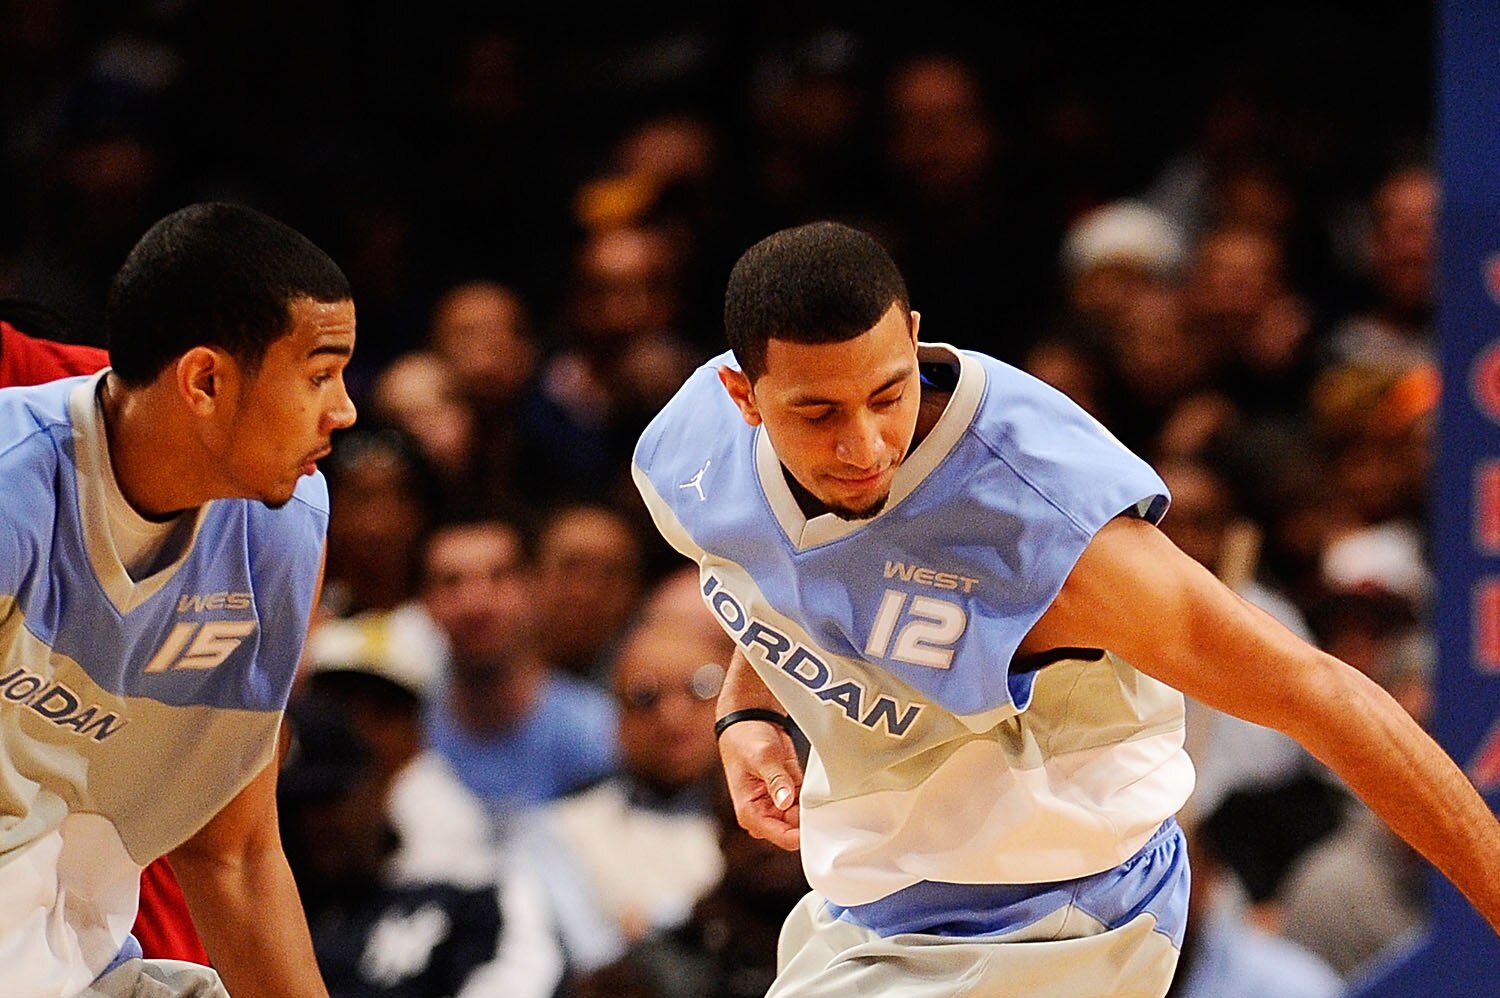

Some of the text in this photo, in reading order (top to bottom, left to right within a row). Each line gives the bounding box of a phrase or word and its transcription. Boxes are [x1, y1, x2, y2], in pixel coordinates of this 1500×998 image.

[176, 591, 252, 613] WES
[883, 560, 979, 593] WEST
[143, 620, 258, 673] 15
[864, 588, 968, 670] 12
[0, 666, 129, 742] JODAN
